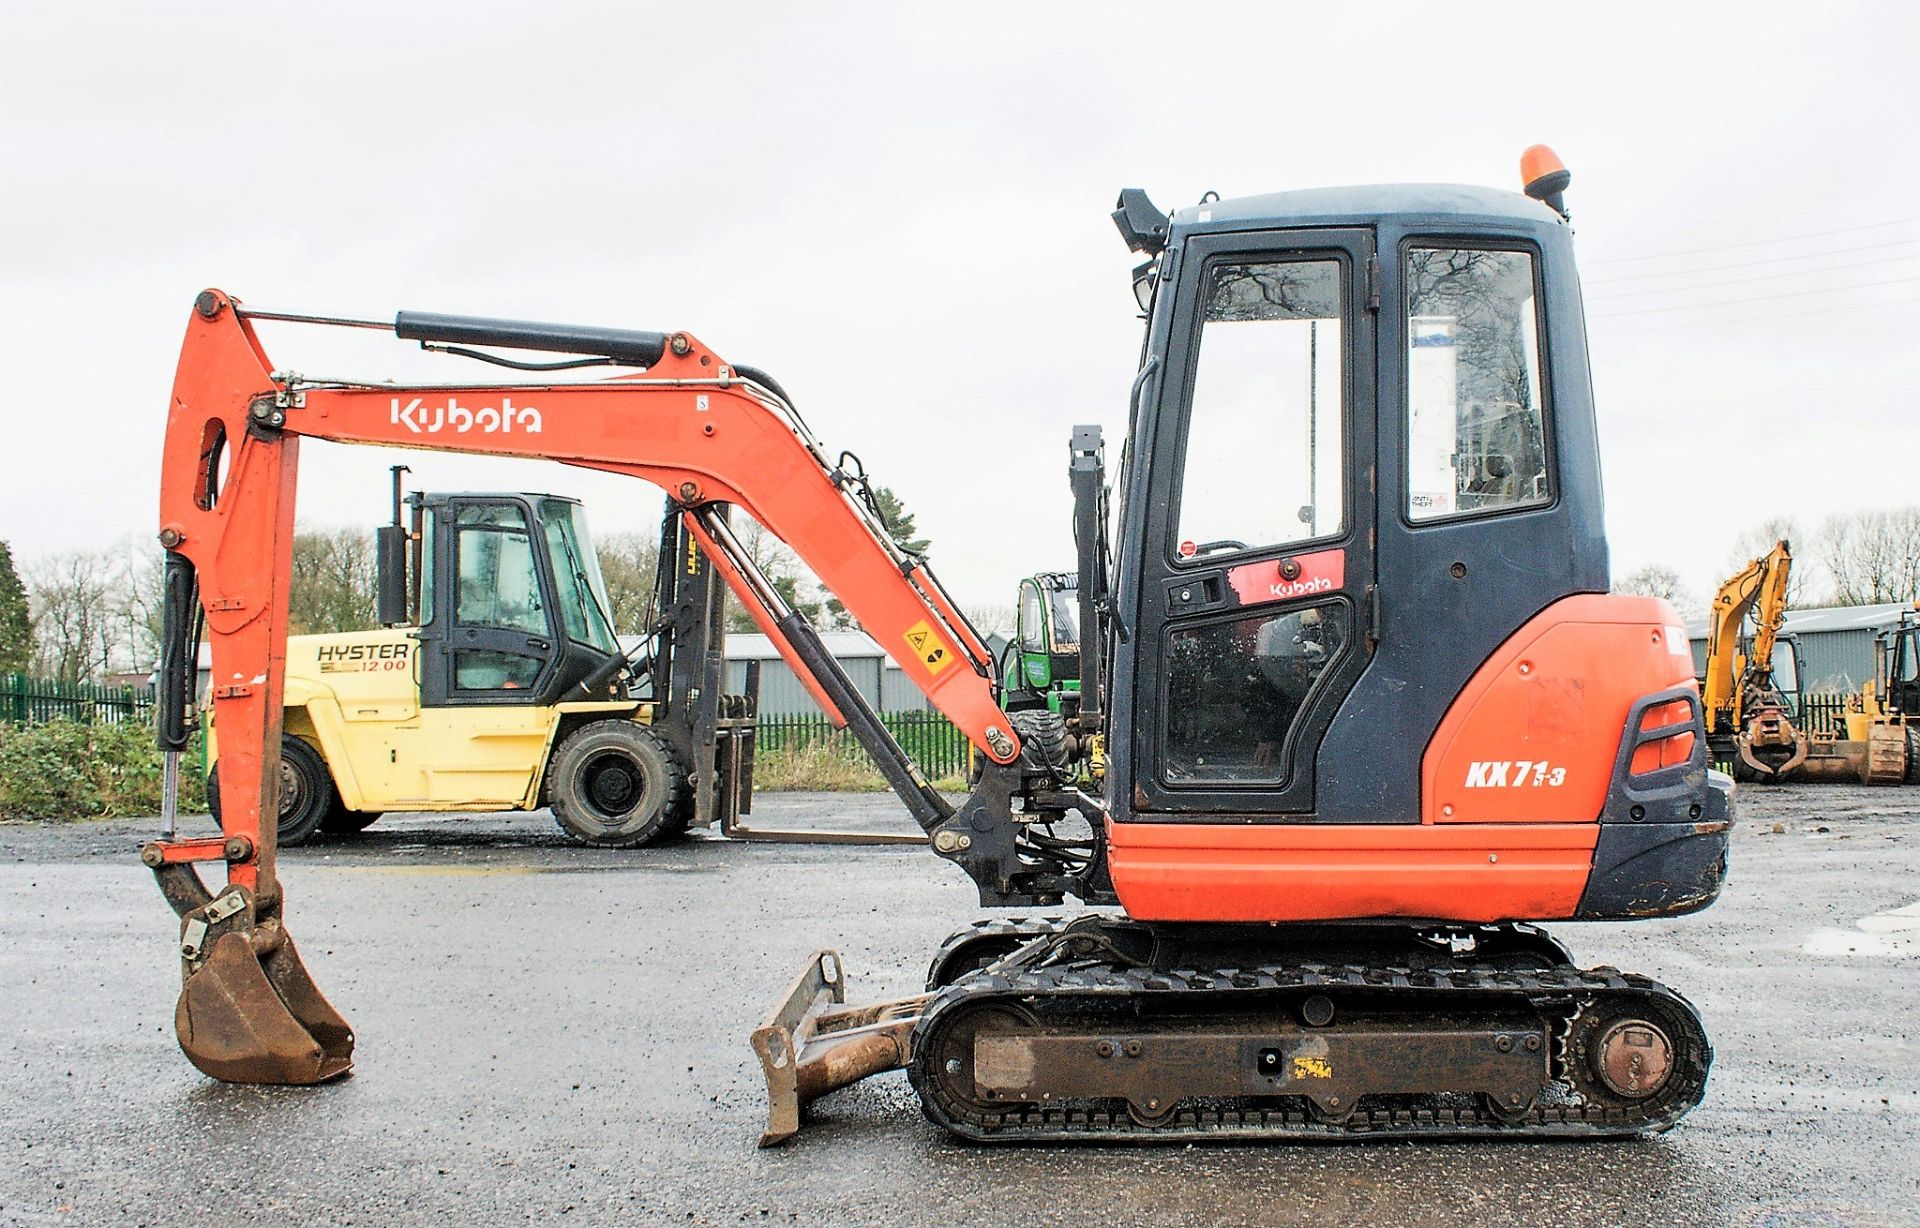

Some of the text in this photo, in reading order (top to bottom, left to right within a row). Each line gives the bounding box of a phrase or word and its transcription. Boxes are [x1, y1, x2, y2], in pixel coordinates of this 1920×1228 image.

[390, 398, 542, 433] Kubota
[1269, 577, 1332, 596] Kubota
[317, 643, 408, 661] HYSTER
